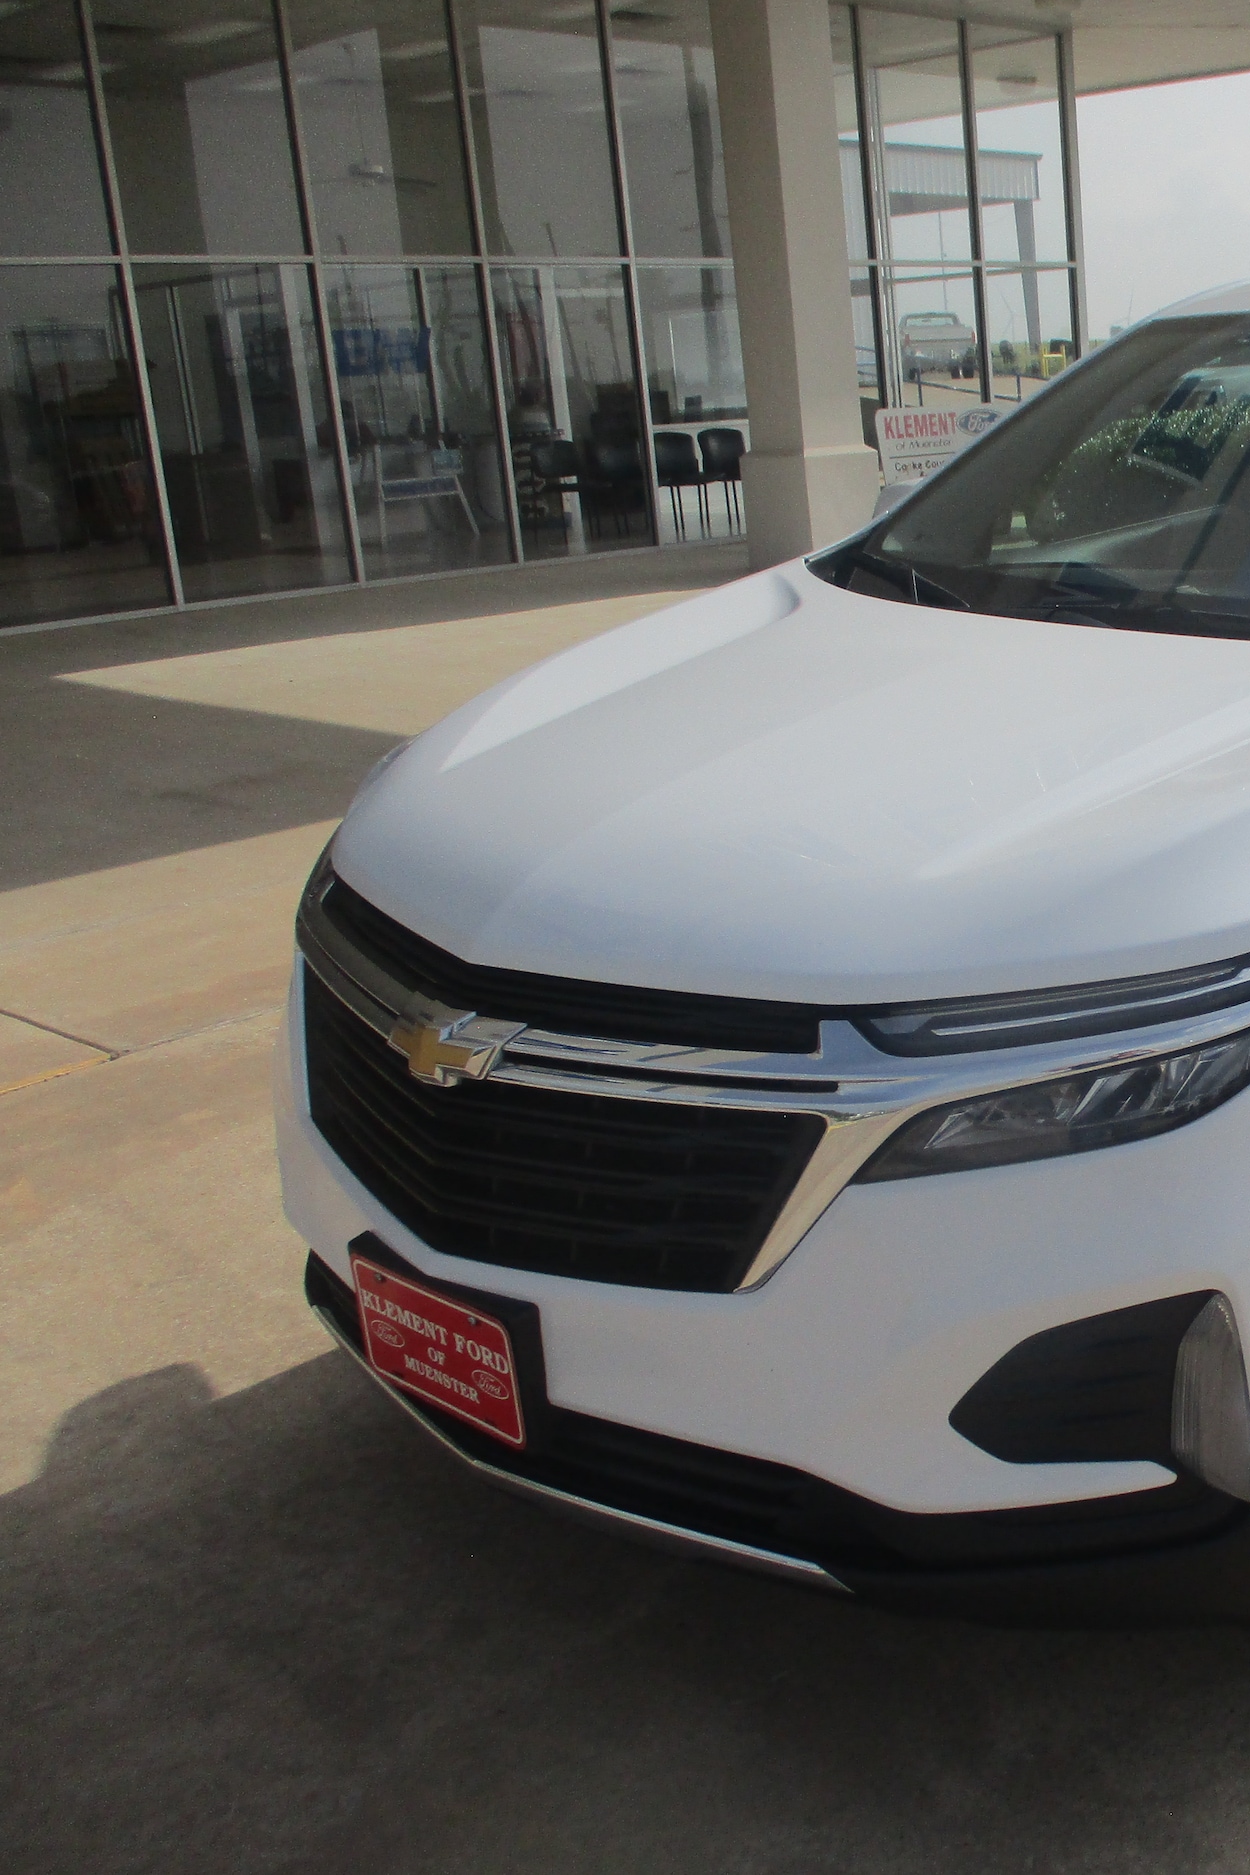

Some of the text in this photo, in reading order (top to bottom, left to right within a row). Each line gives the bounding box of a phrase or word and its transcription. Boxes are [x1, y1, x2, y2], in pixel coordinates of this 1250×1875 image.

[884, 412, 957, 440] KLEMENT
[360, 1289, 510, 1375] KLEMENT FORD
[428, 1347, 446, 1366] OF
[404, 1354, 480, 1404] MUENSTER
